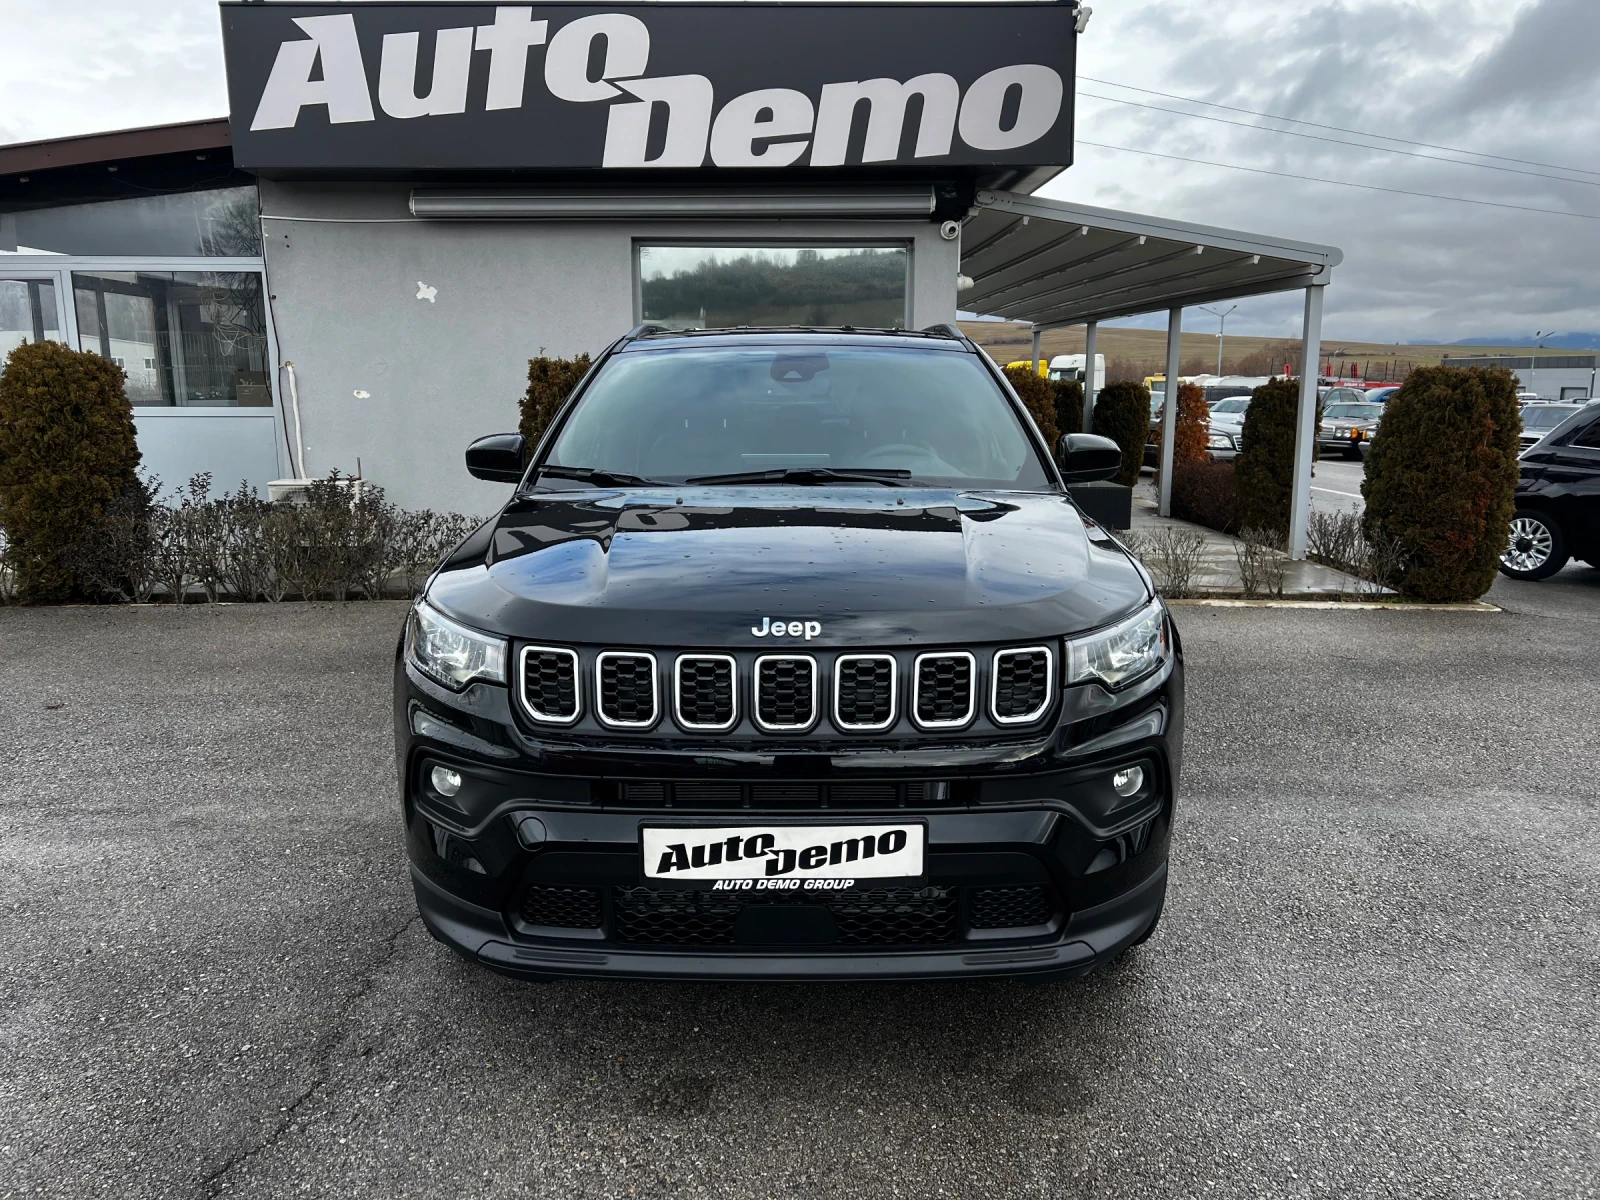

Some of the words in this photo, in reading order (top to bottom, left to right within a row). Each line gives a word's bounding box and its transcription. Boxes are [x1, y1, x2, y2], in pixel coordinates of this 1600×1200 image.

[250, 6, 650, 131] Auto
[602, 64, 1063, 168] Demo
[751, 617, 821, 640] Jeep
[656, 833, 775, 874] Auto
[765, 830, 906, 876] Demo
[712, 880, 753, 890] AUTO
[756, 879, 800, 890] DEMO
[803, 879, 855, 890] GROUP
